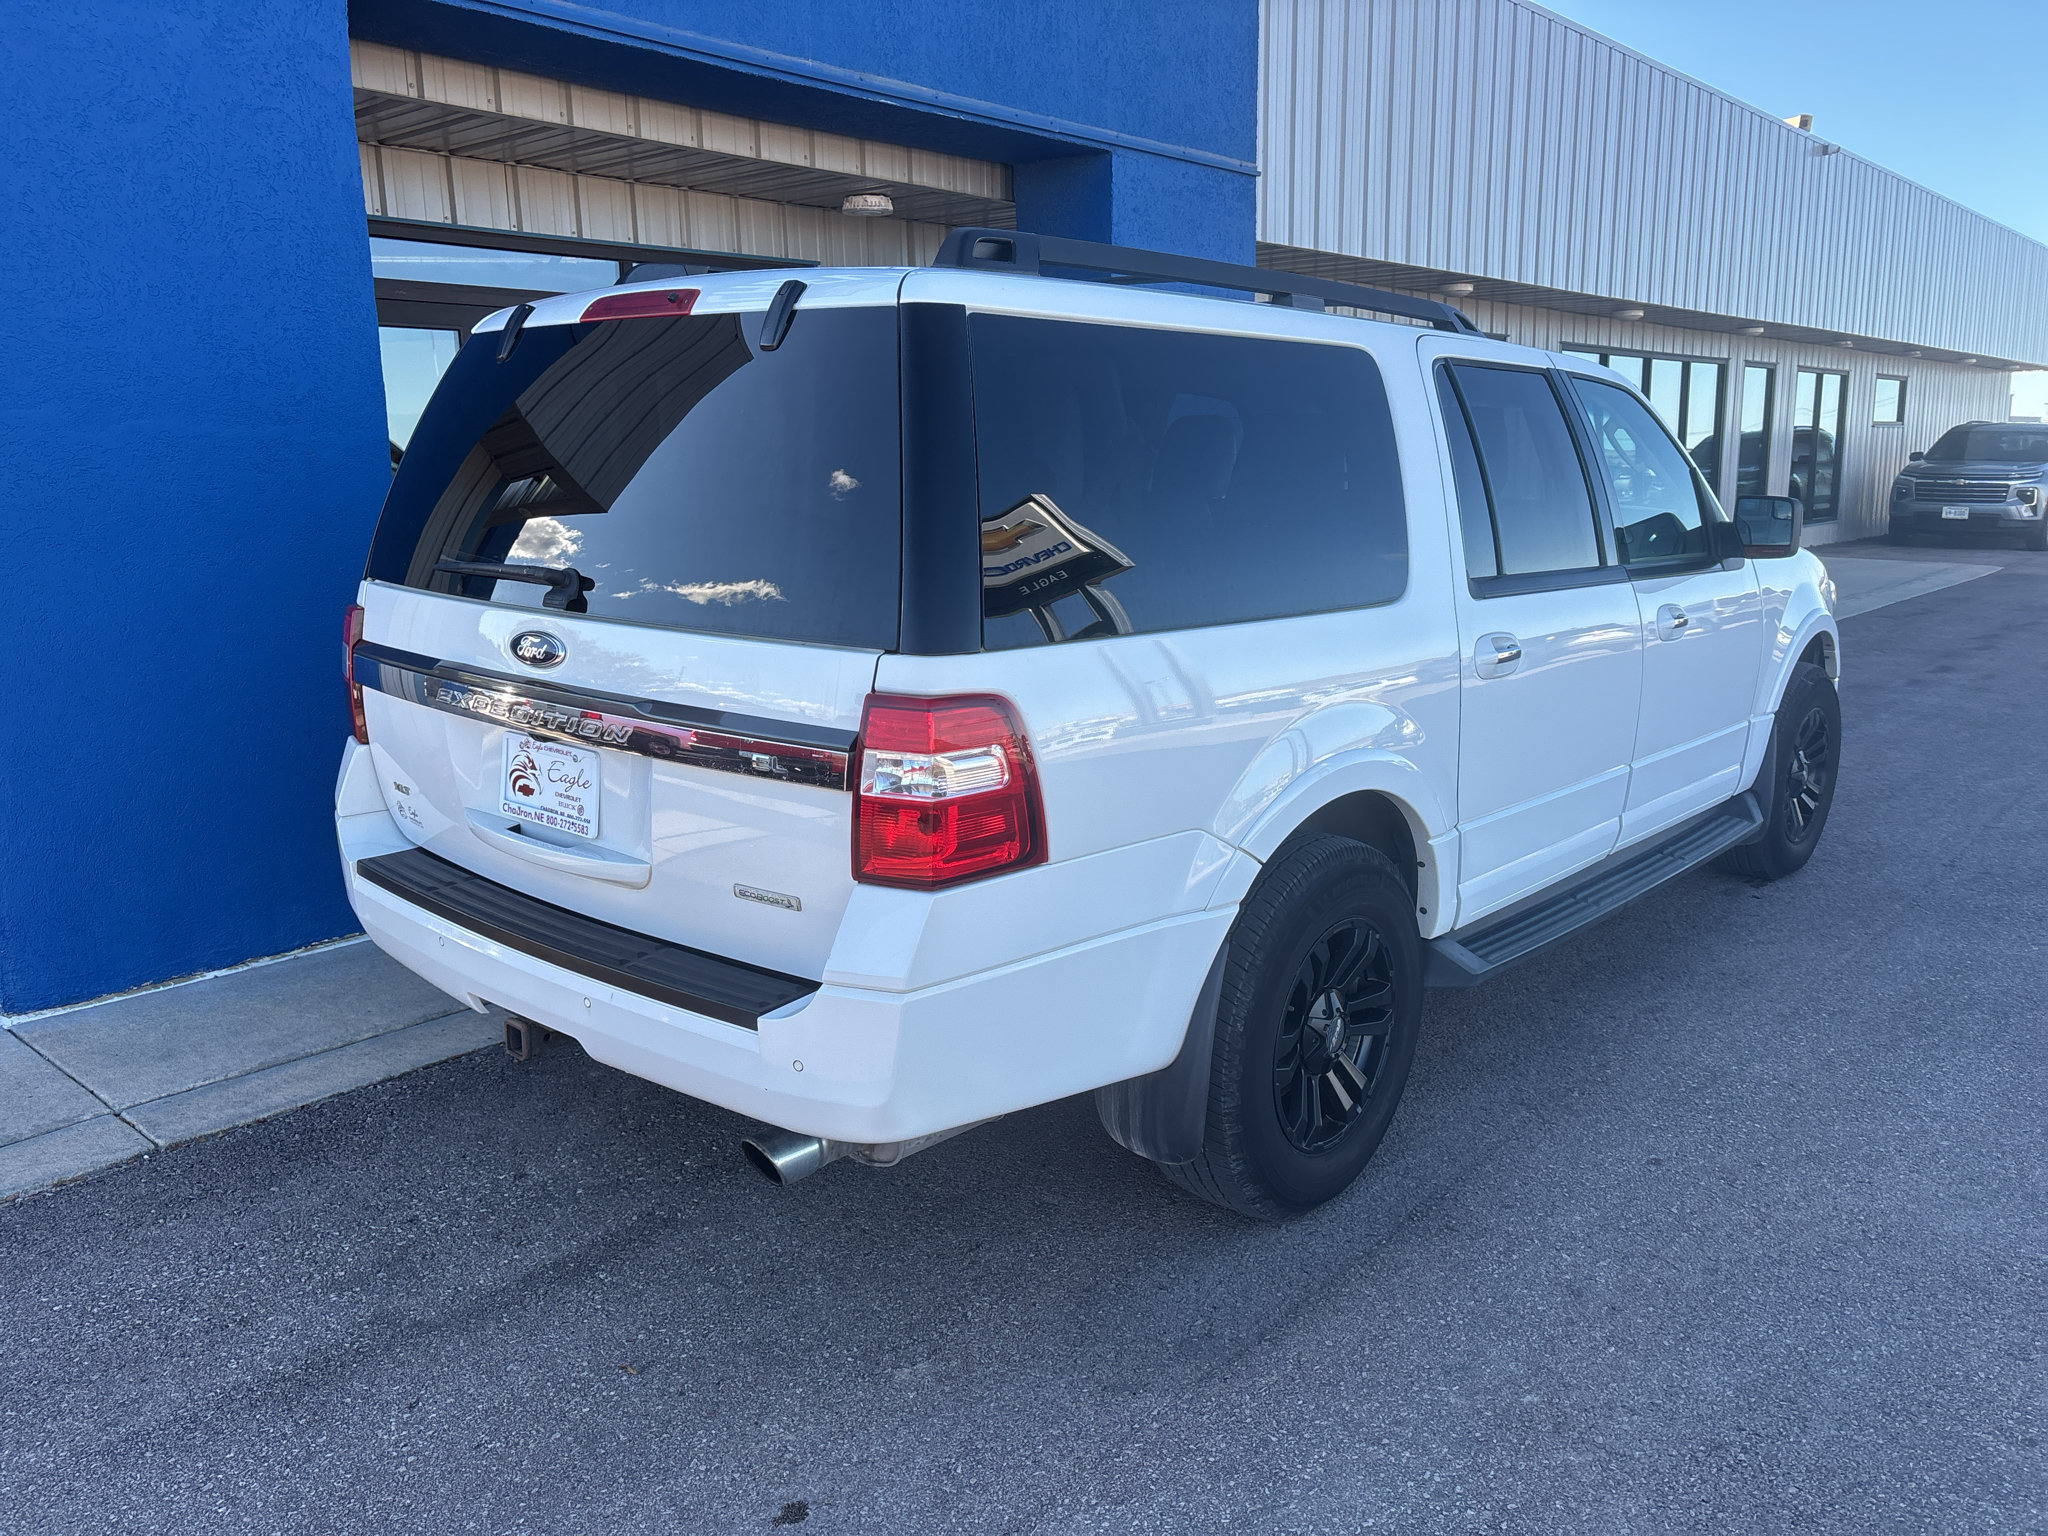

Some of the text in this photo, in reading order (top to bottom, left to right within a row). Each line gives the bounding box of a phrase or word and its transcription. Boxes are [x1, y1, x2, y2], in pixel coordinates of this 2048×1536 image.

[516, 635, 548, 660] Ford
[436, 687, 634, 744] EXPEDITION
[547, 760, 592, 793] Eagle
[546, 814, 589, 836] 800-272-5583
